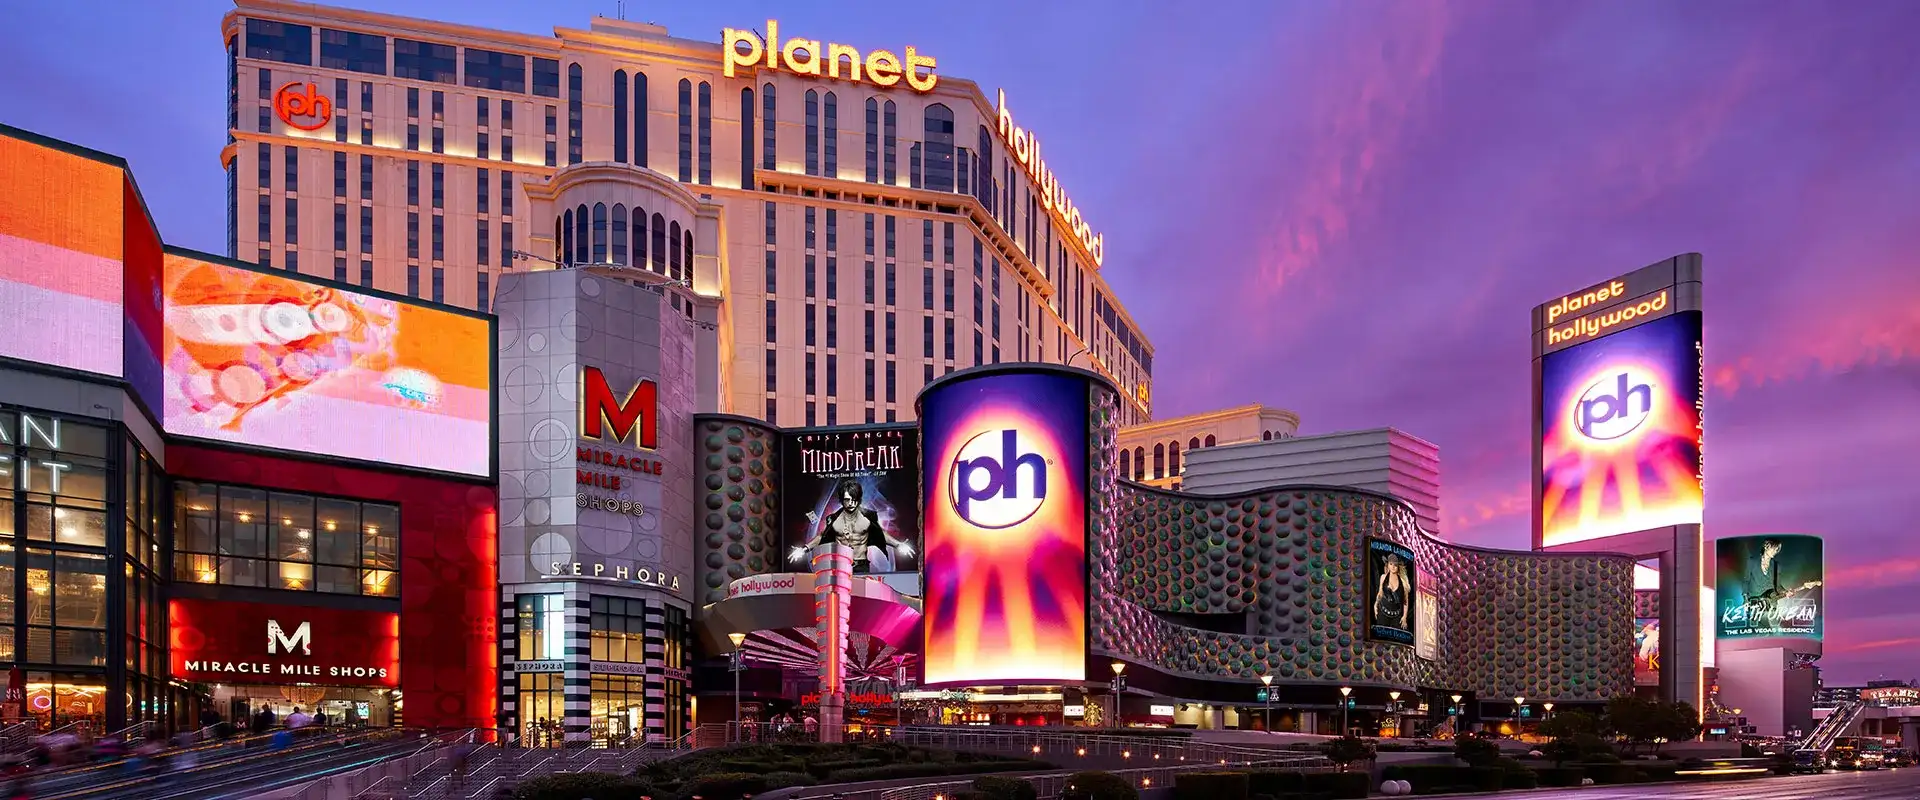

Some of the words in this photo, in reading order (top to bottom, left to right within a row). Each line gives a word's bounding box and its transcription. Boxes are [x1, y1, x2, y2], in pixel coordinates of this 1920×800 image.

[722, 19, 937, 92] planet
[276, 82, 331, 127] ph
[998, 88, 1103, 268] hollywood
[1548, 281, 1625, 324] planet
[1548, 290, 1668, 346] hollywood
[581, 364, 658, 450] M
[1576, 373, 1652, 438] ph
[797, 434, 841, 443] CRISS
[852, 430, 904, 440] ANGEL
[576, 446, 663, 476] MIRACLE
[801, 445, 901, 473] MINDFREAK
[576, 469, 621, 491] MILE
[951, 430, 1047, 524] ph
[576, 492, 644, 516] SHOPS
[551, 562, 680, 590] SEPHORA
[741, 576, 795, 593] hollywood
[1722, 600, 1767, 623] KEITH
[1767, 600, 1817, 621] URBAN
[268, 619, 311, 656] M
[184, 660, 271, 674] MIRACLE
[280, 664, 321, 676] MILE
[330, 666, 388, 678] SHOPS
[516, 662, 564, 671] SEPHORA
[592, 663, 645, 674] SEPHORA
